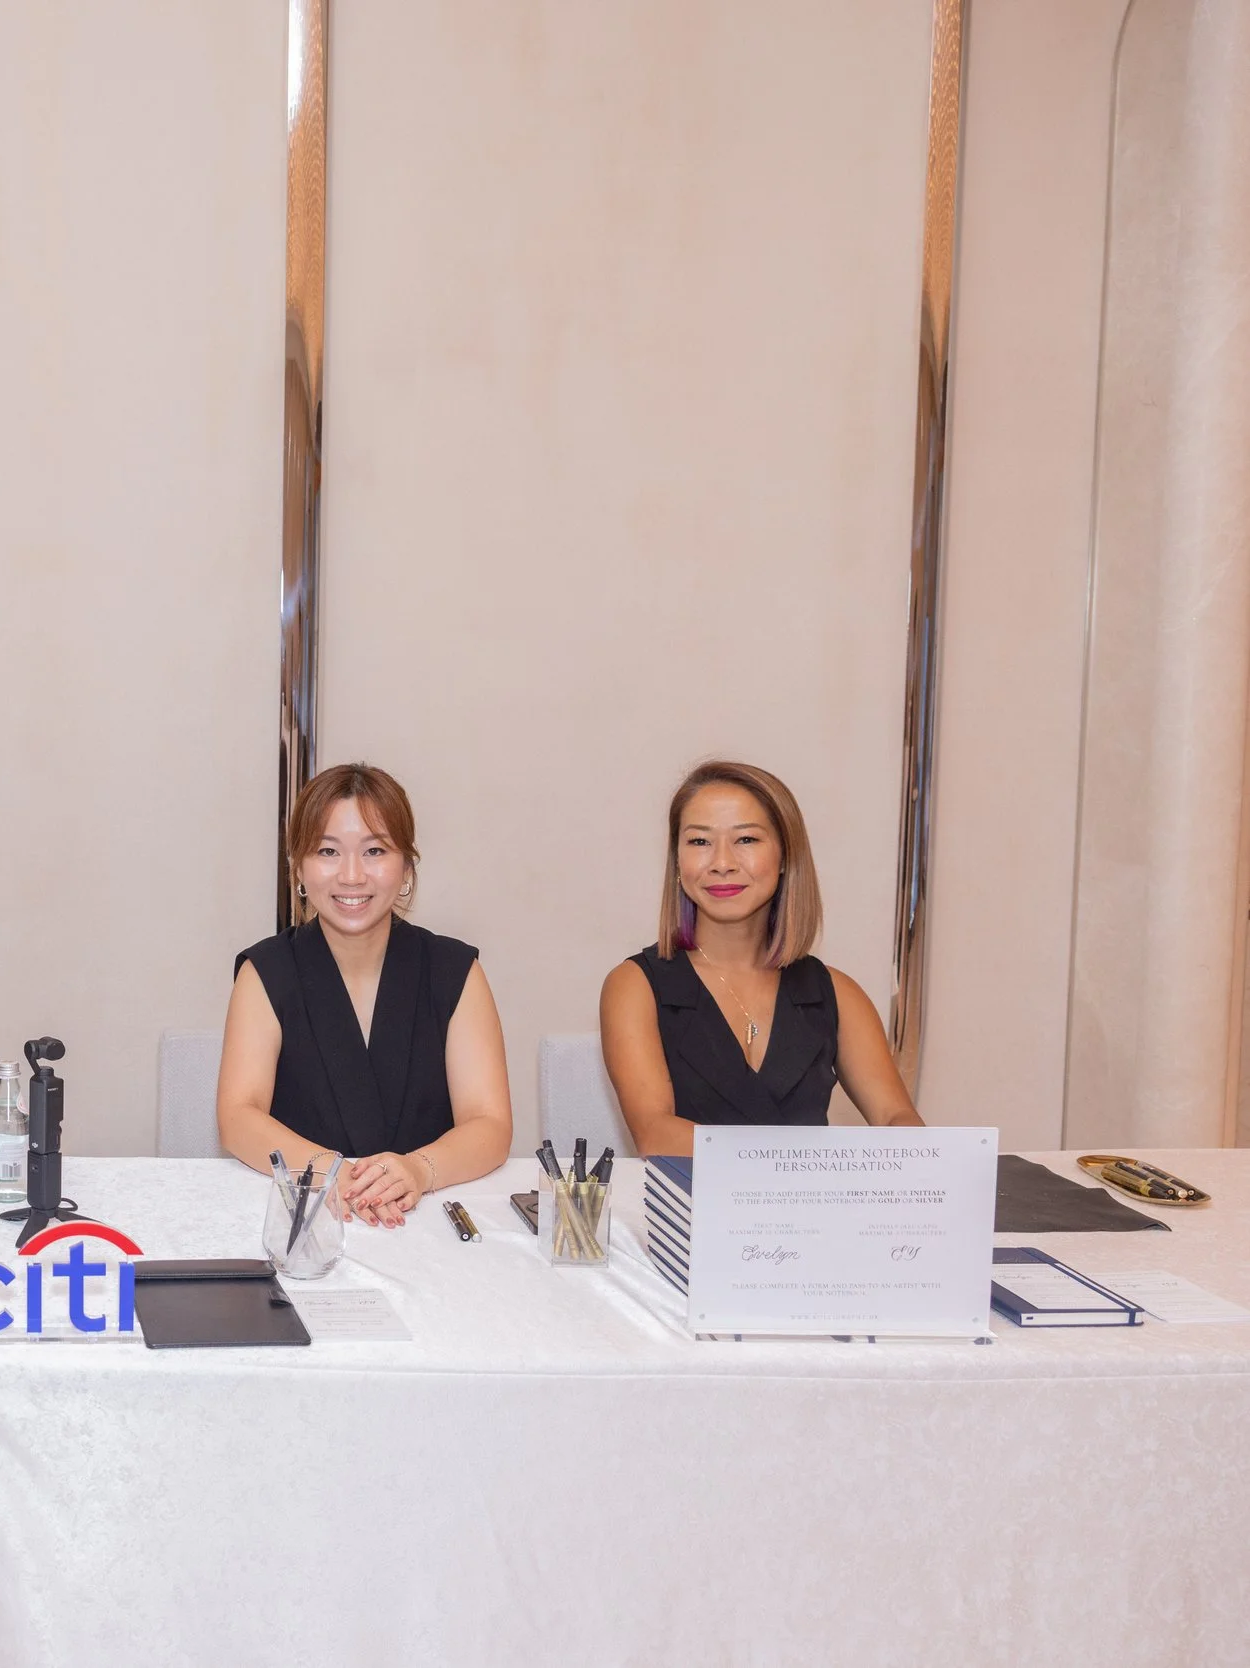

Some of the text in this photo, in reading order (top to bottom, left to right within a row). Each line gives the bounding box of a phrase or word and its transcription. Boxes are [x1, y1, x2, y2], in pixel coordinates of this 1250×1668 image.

[737, 1147, 940, 1160] COMPLIMENTARY NOTEBOOK
[775, 1160, 903, 1172] PERSONALISATION
[741, 1244, 801, 1265] Evelyn
